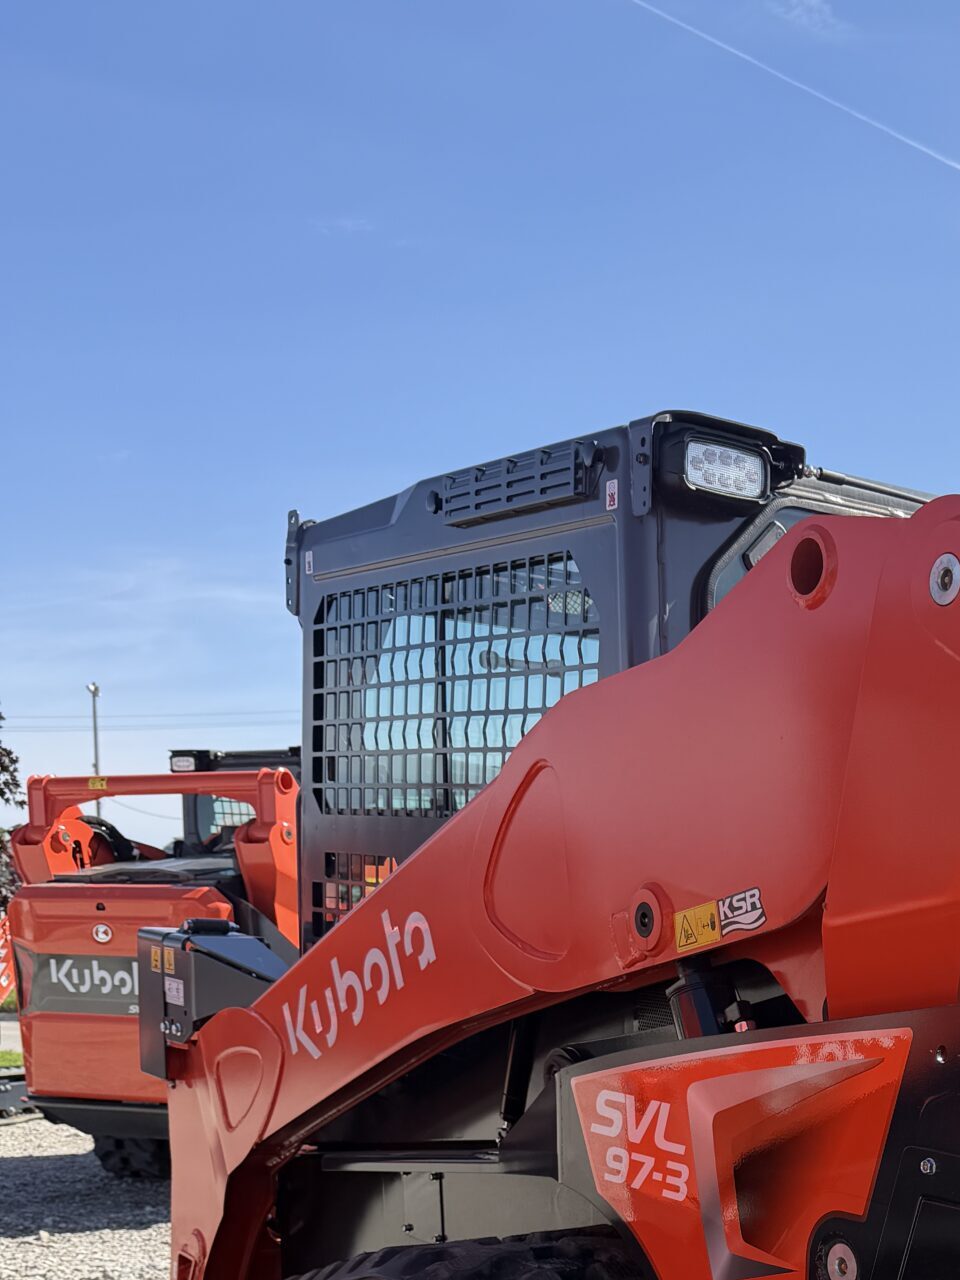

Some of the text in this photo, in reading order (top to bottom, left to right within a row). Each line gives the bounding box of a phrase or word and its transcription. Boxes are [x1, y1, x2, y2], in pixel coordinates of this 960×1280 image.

[718, 888, 762, 921] KSR
[281, 908, 437, 1060] Kubota
[590, 1089, 686, 1156] SVL
[604, 1146, 690, 1202] 97-3
